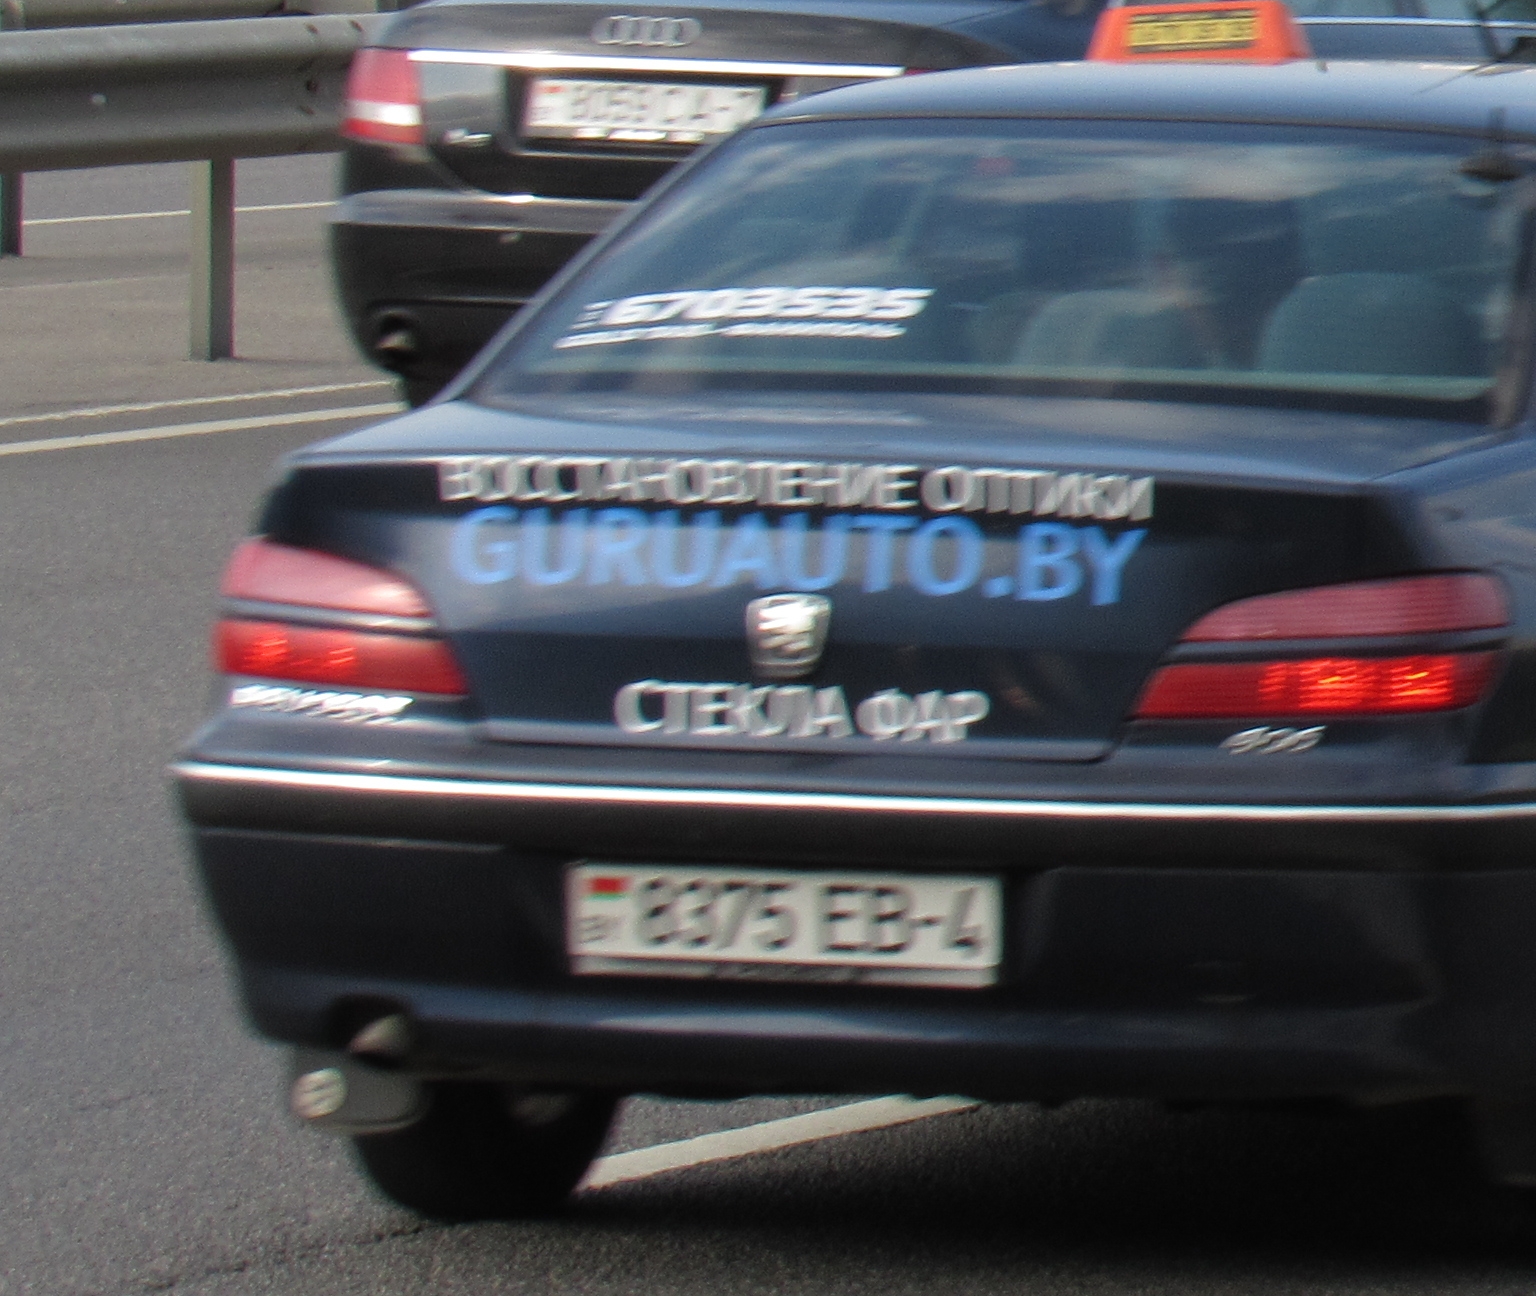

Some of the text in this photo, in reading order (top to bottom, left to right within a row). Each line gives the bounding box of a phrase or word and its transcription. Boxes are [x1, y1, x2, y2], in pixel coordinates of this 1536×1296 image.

[437, 457, 1156, 521] ВОССТАНОВЛЕНИЕ ОПТИКИ
[447, 505, 1149, 606] GURUAUTO.BY
[613, 678, 990, 744] СТЕКЛА ФАР
[635, 875, 801, 953] 8375
